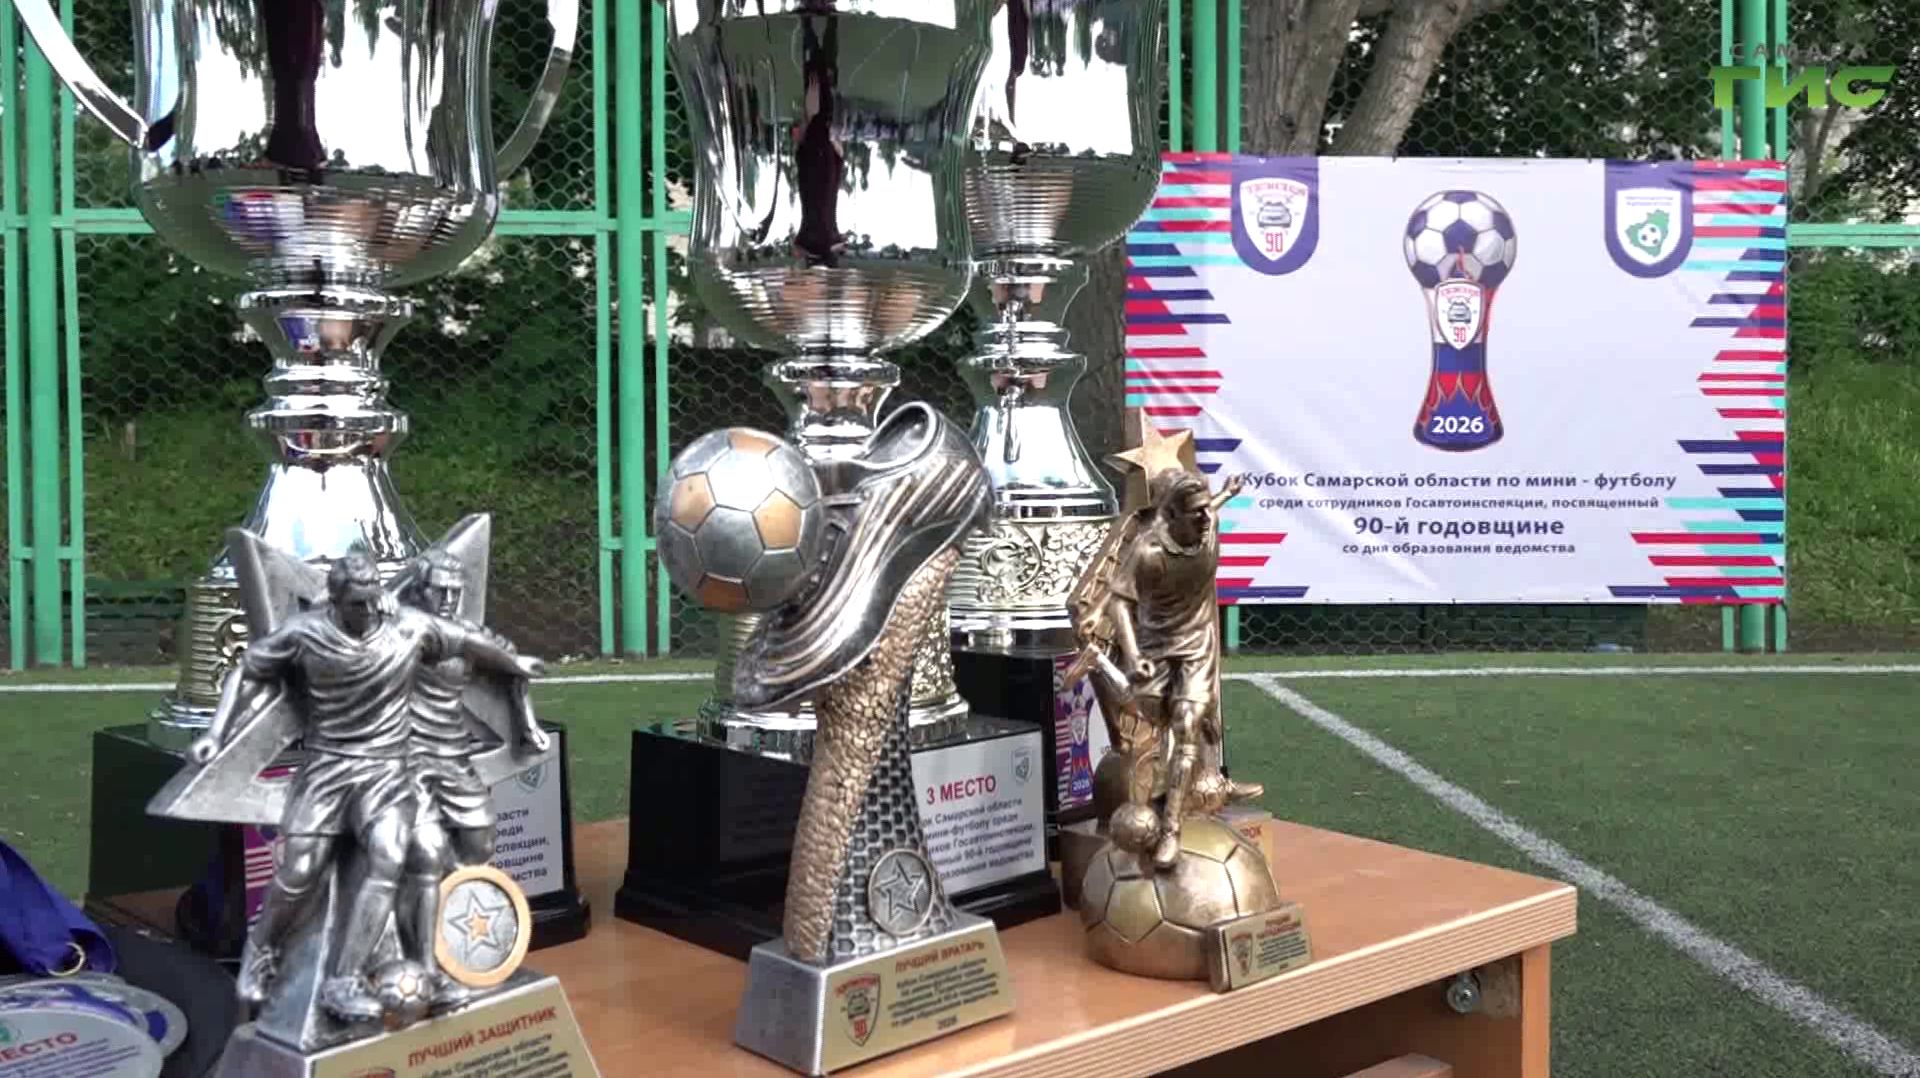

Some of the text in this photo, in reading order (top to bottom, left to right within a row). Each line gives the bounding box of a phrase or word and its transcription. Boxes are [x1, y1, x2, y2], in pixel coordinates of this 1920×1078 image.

[1265, 231, 1283, 253] 90
[1453, 326, 1466, 343] 90
[1431, 415, 1484, 434] 2026
[1242, 472, 1298, 490] Кубок
[1303, 472, 1409, 490] Самарской
[1414, 472, 1491, 488] области
[1497, 476, 1521, 488] по
[1525, 476, 1577, 488] мини
[1594, 472, 1677, 491] футболу
[1258, 497, 1660, 511] среди сотрудников Госавтоинспекции, посвященный
[1353, 515, 1565, 539] 90-й годовщине
[1342, 542, 1576, 556] со дня образования ведомства
[926, 774, 997, 805] 3 МЕСТО
[0, 1032, 78, 1061] ЕСТО
[407, 1033, 474, 1068] ЛУЧШИЙ
[478, 1006, 557, 1044] ЗАЩИТНИК
